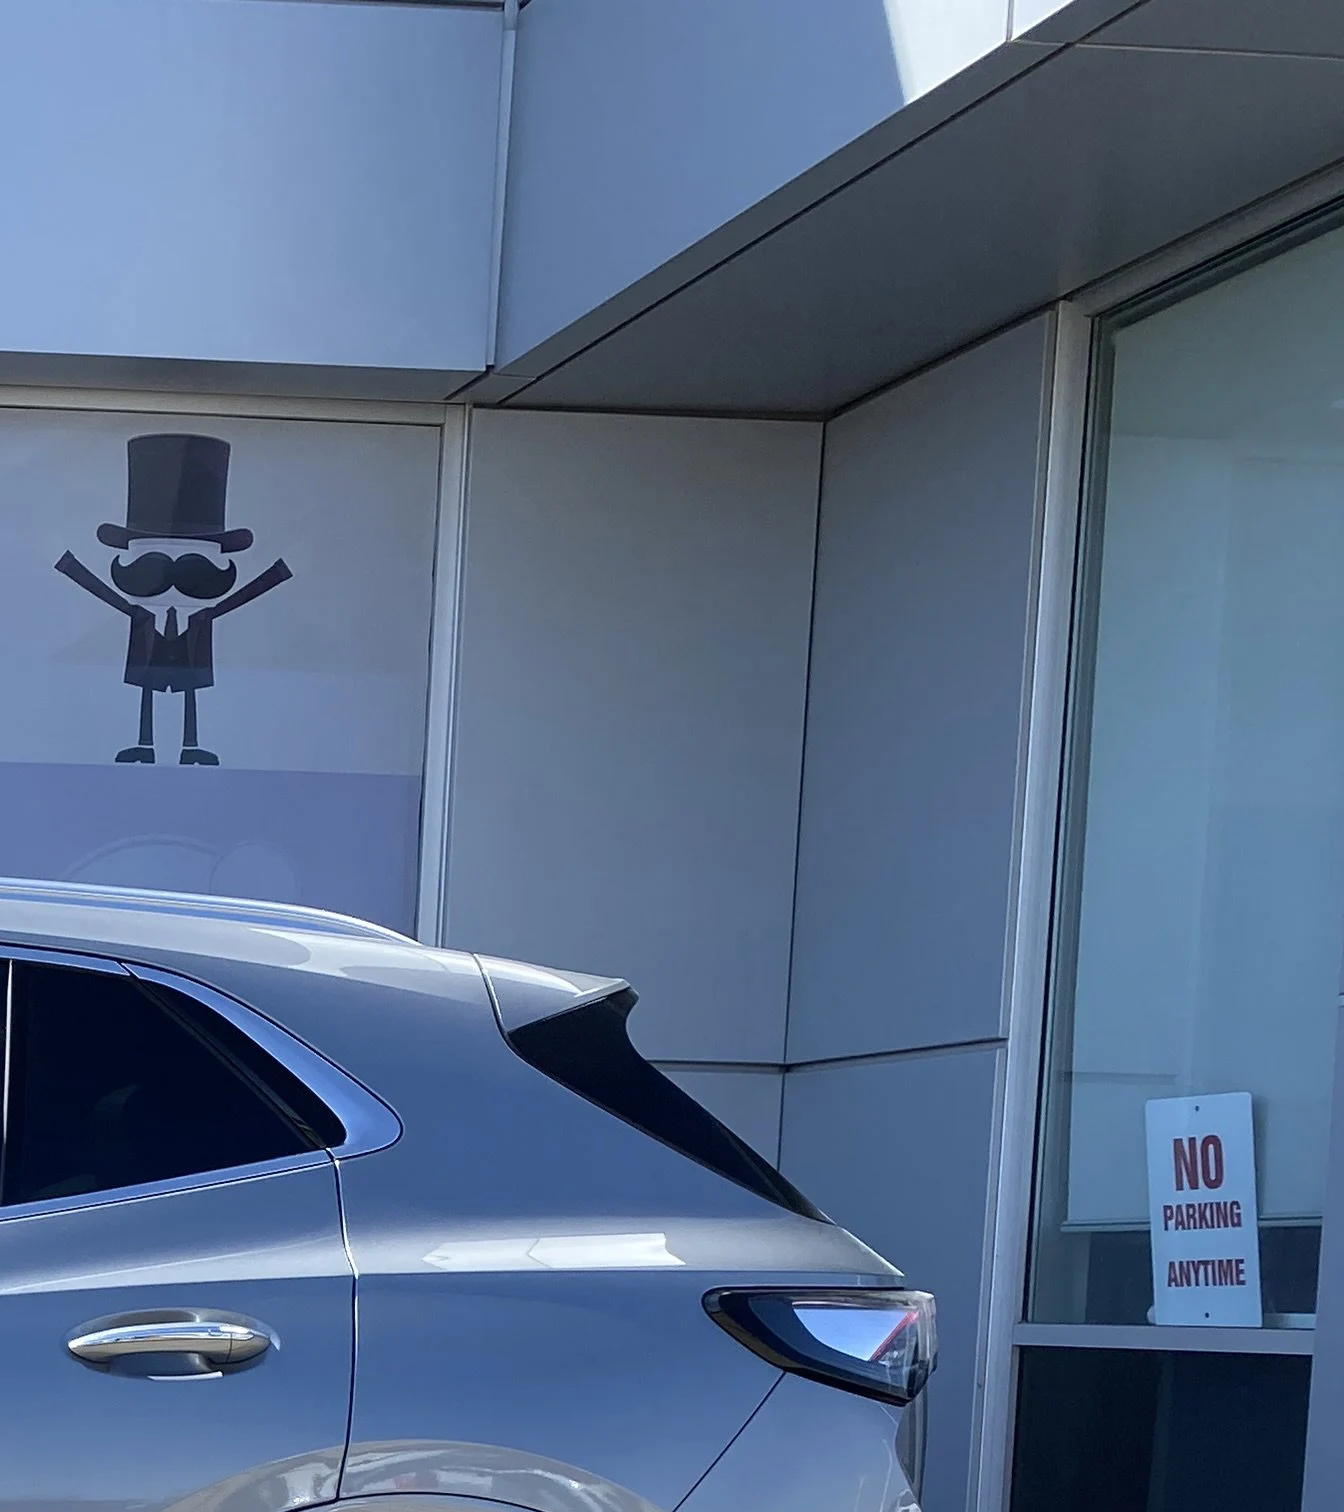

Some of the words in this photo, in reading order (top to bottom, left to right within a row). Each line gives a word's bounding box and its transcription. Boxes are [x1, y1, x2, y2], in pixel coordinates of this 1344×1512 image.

[1173, 1134, 1225, 1191] NO
[1163, 1201, 1243, 1232] PARKING
[1167, 1258, 1247, 1288] ANYTIME
